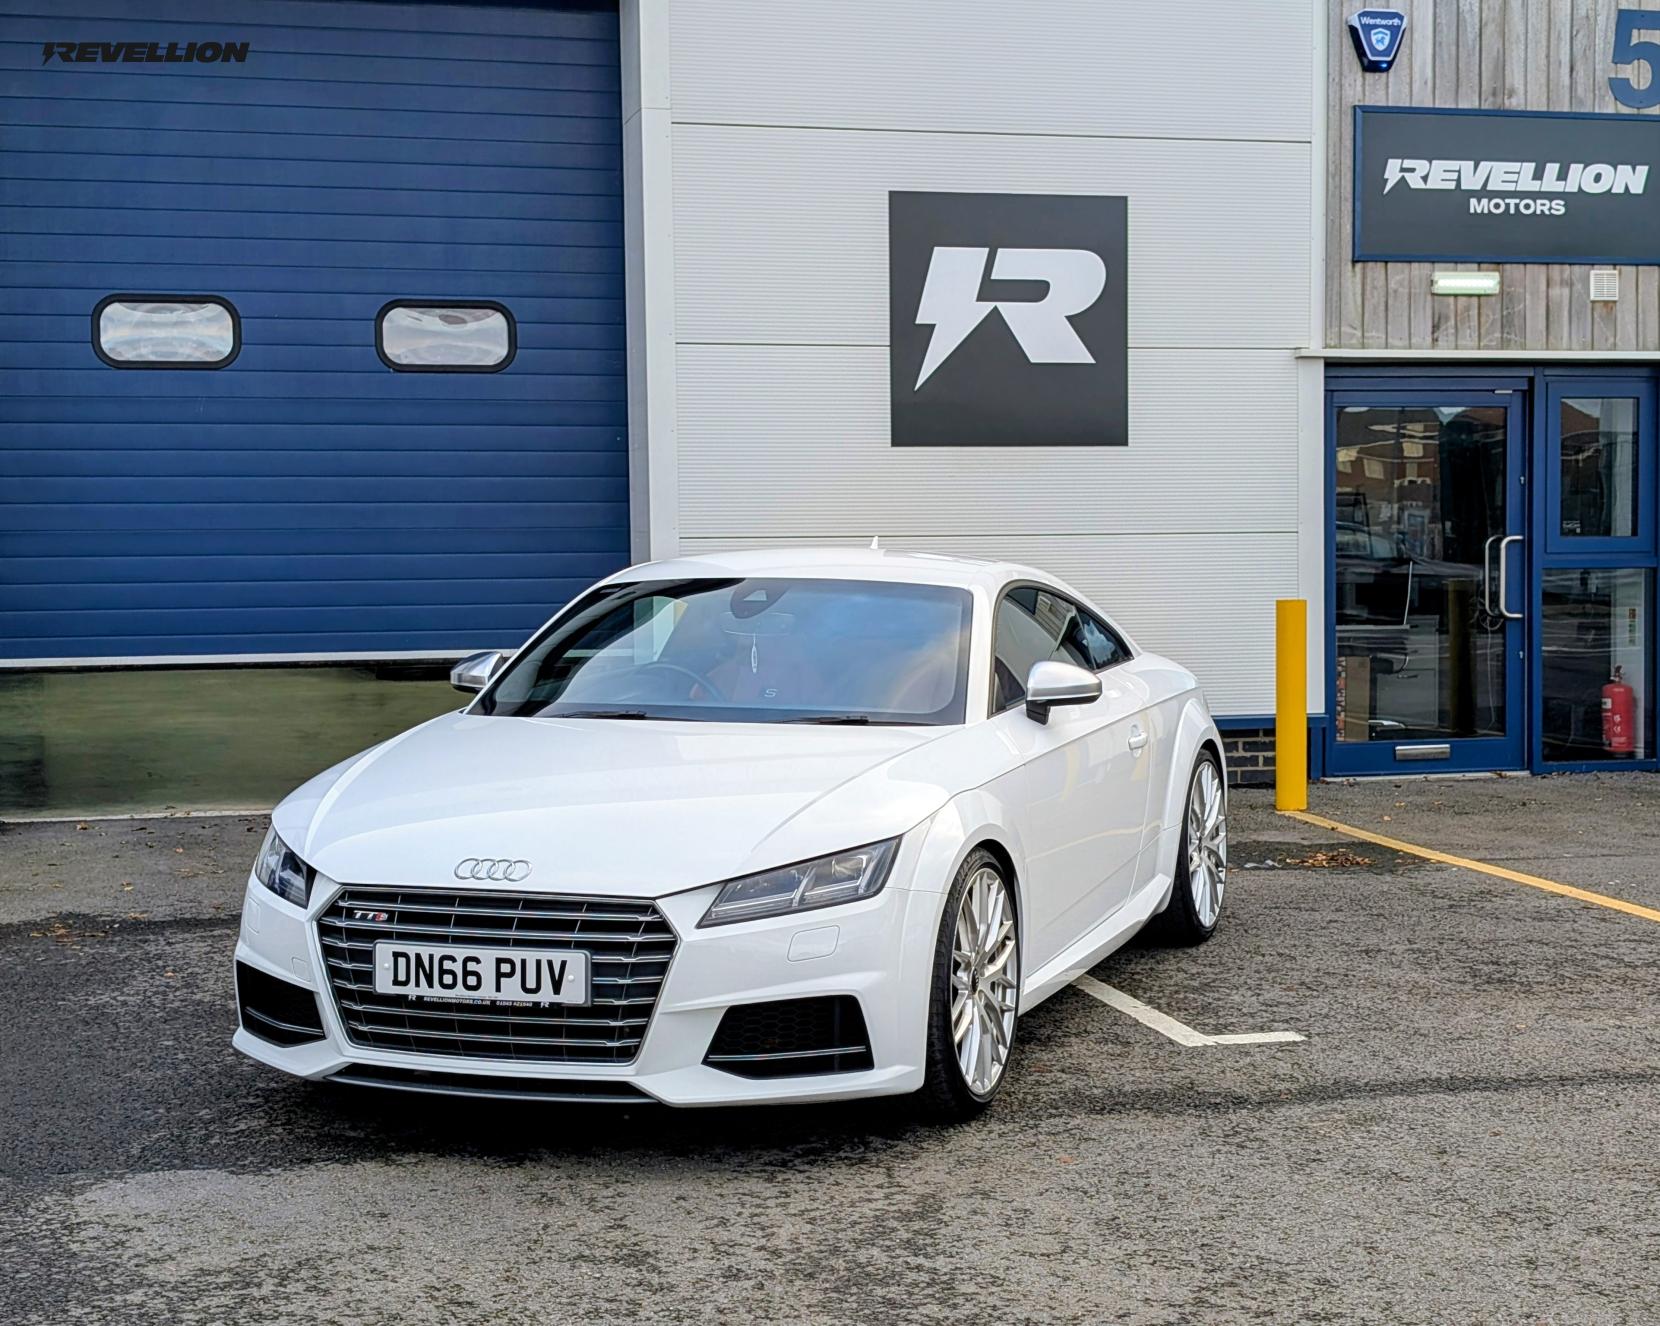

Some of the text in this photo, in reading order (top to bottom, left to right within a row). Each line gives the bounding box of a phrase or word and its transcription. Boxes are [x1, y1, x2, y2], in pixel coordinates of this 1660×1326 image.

[1360, 16, 1402, 26] Wentworth
[1607, 8, 1660, 109] 5
[1383, 158, 1650, 195] REVELLION
[1469, 198, 1567, 215] MOTORS
[913, 246, 1107, 392] R
[353, 910, 389, 922] TTS
[391, 951, 568, 996] DN66 PUV
